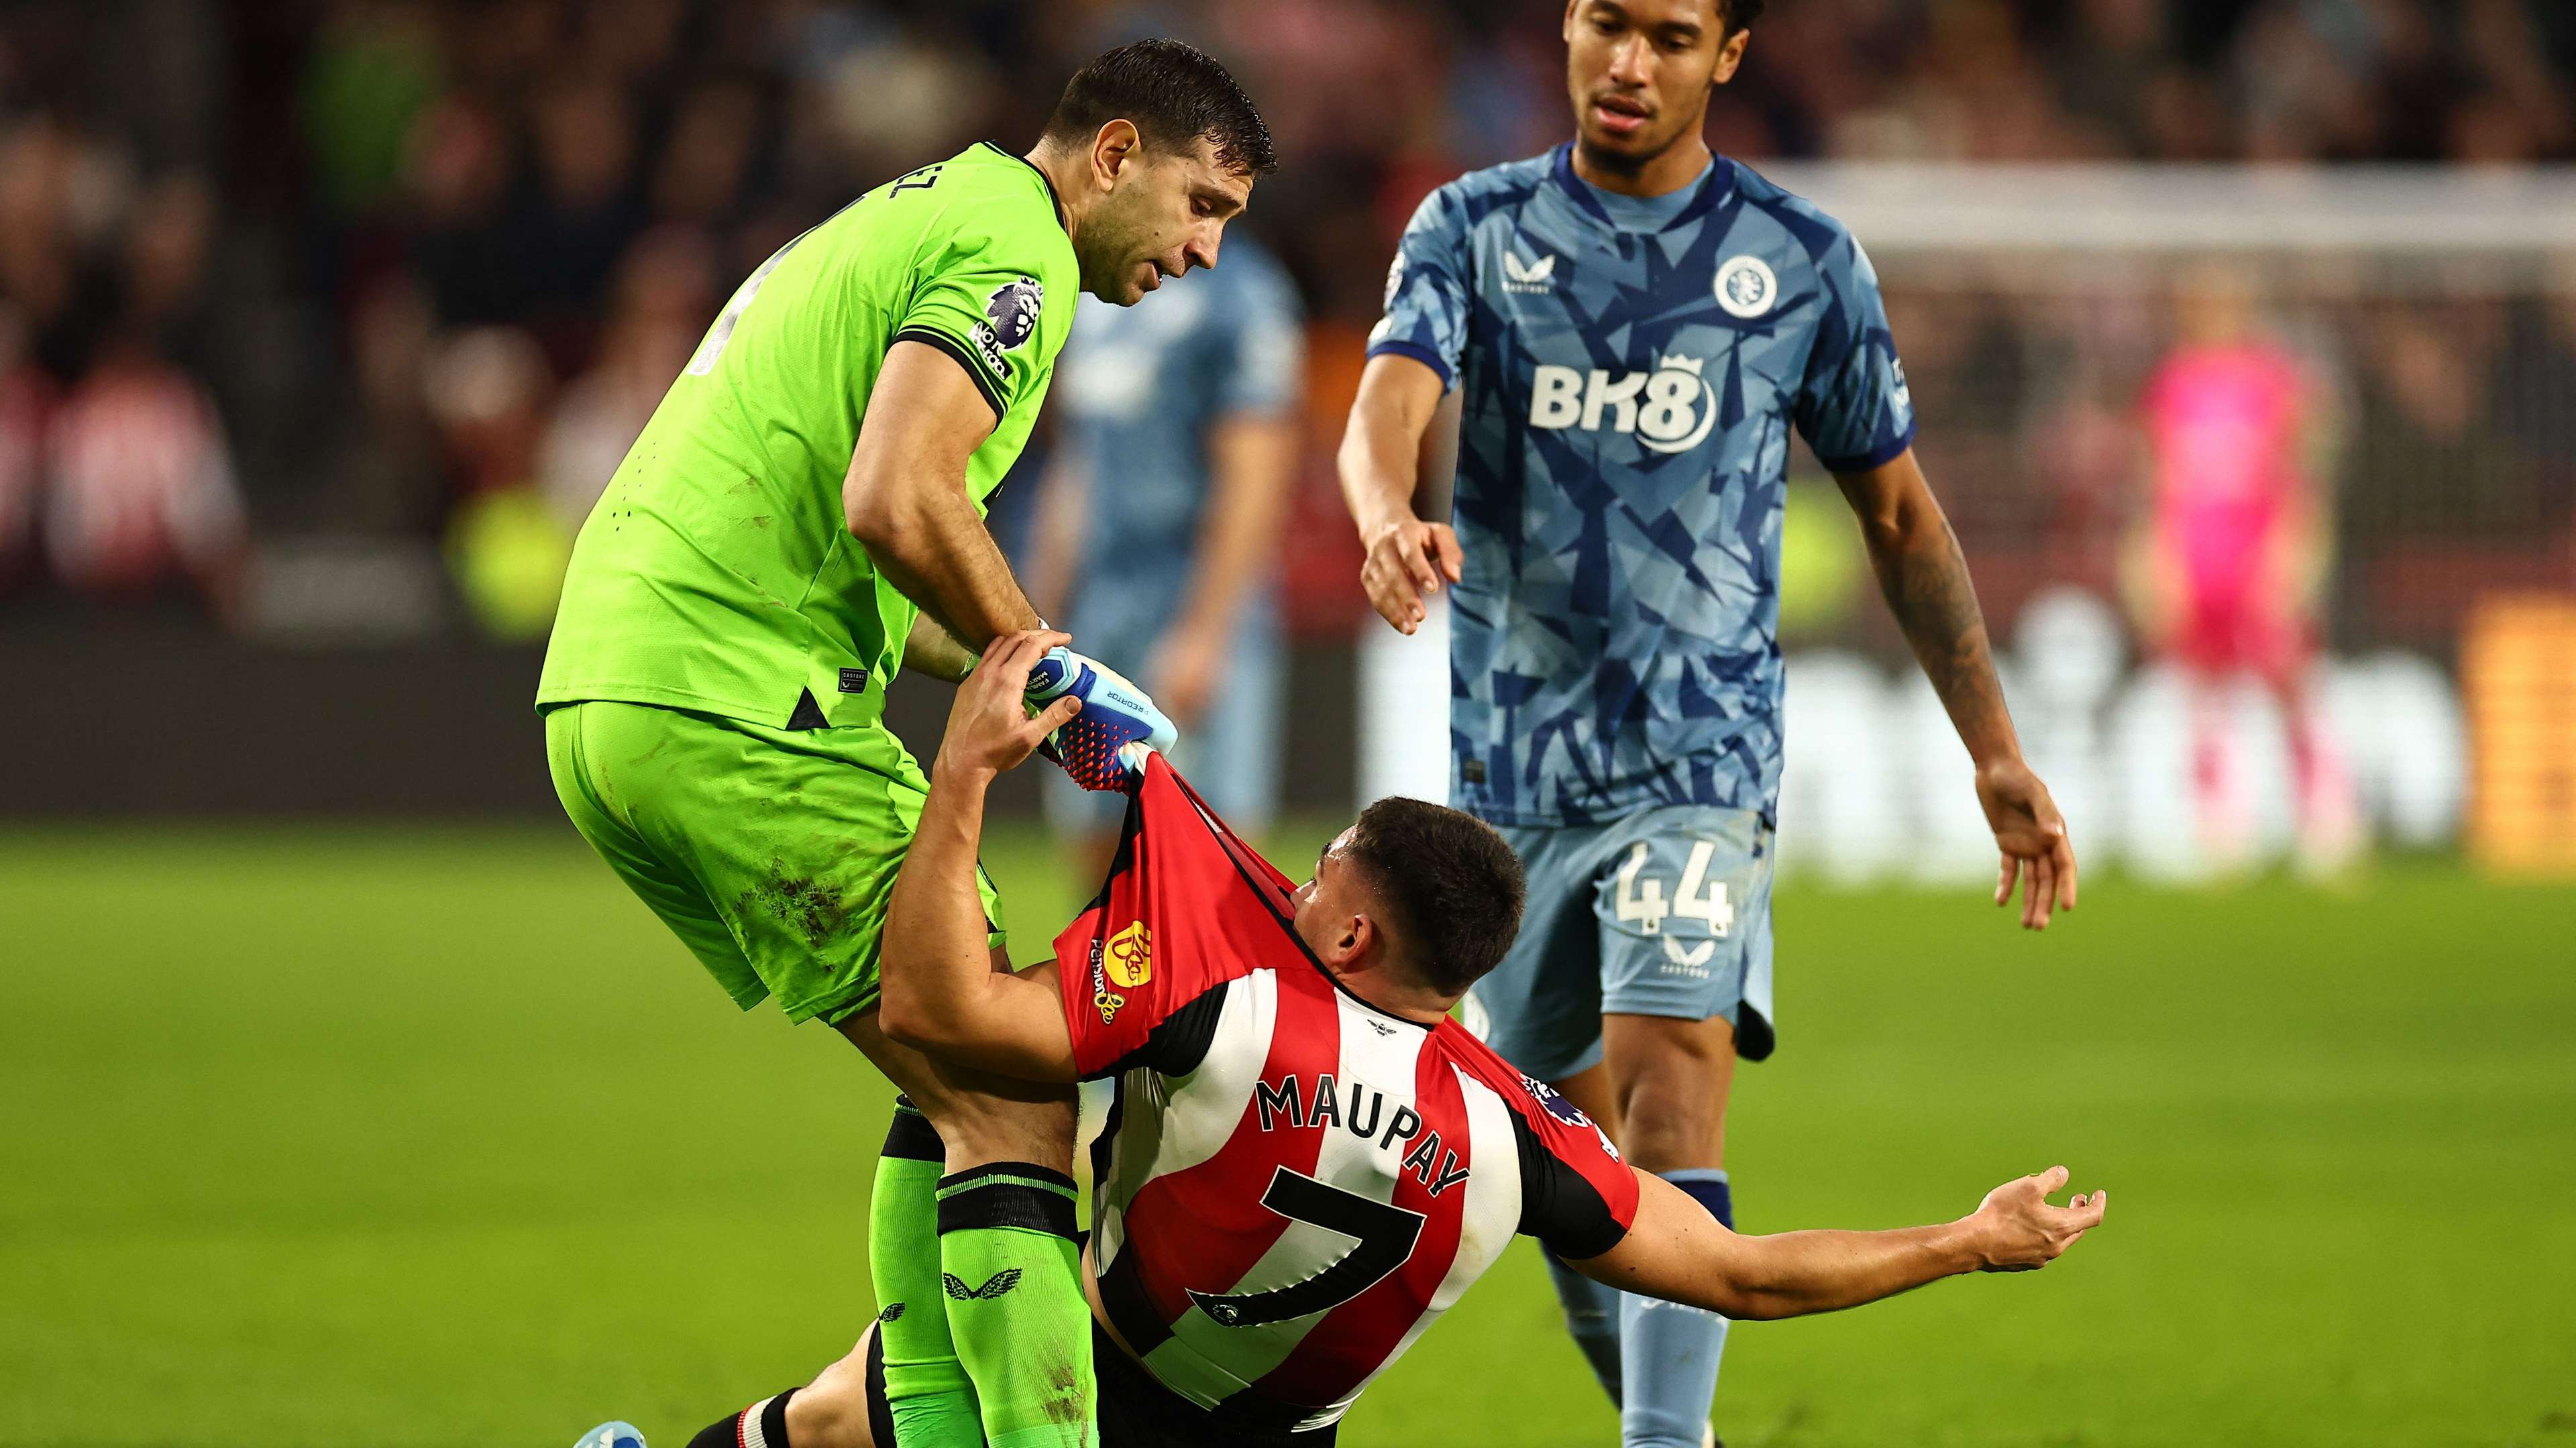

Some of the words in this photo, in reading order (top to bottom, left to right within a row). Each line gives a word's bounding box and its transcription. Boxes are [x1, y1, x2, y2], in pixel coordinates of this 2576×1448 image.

[1529, 361, 1707, 446] BK8
[1615, 840, 1734, 938] 44
[1254, 1074, 1471, 1198] MAUPAY
[1185, 1164, 1428, 1328] 7
